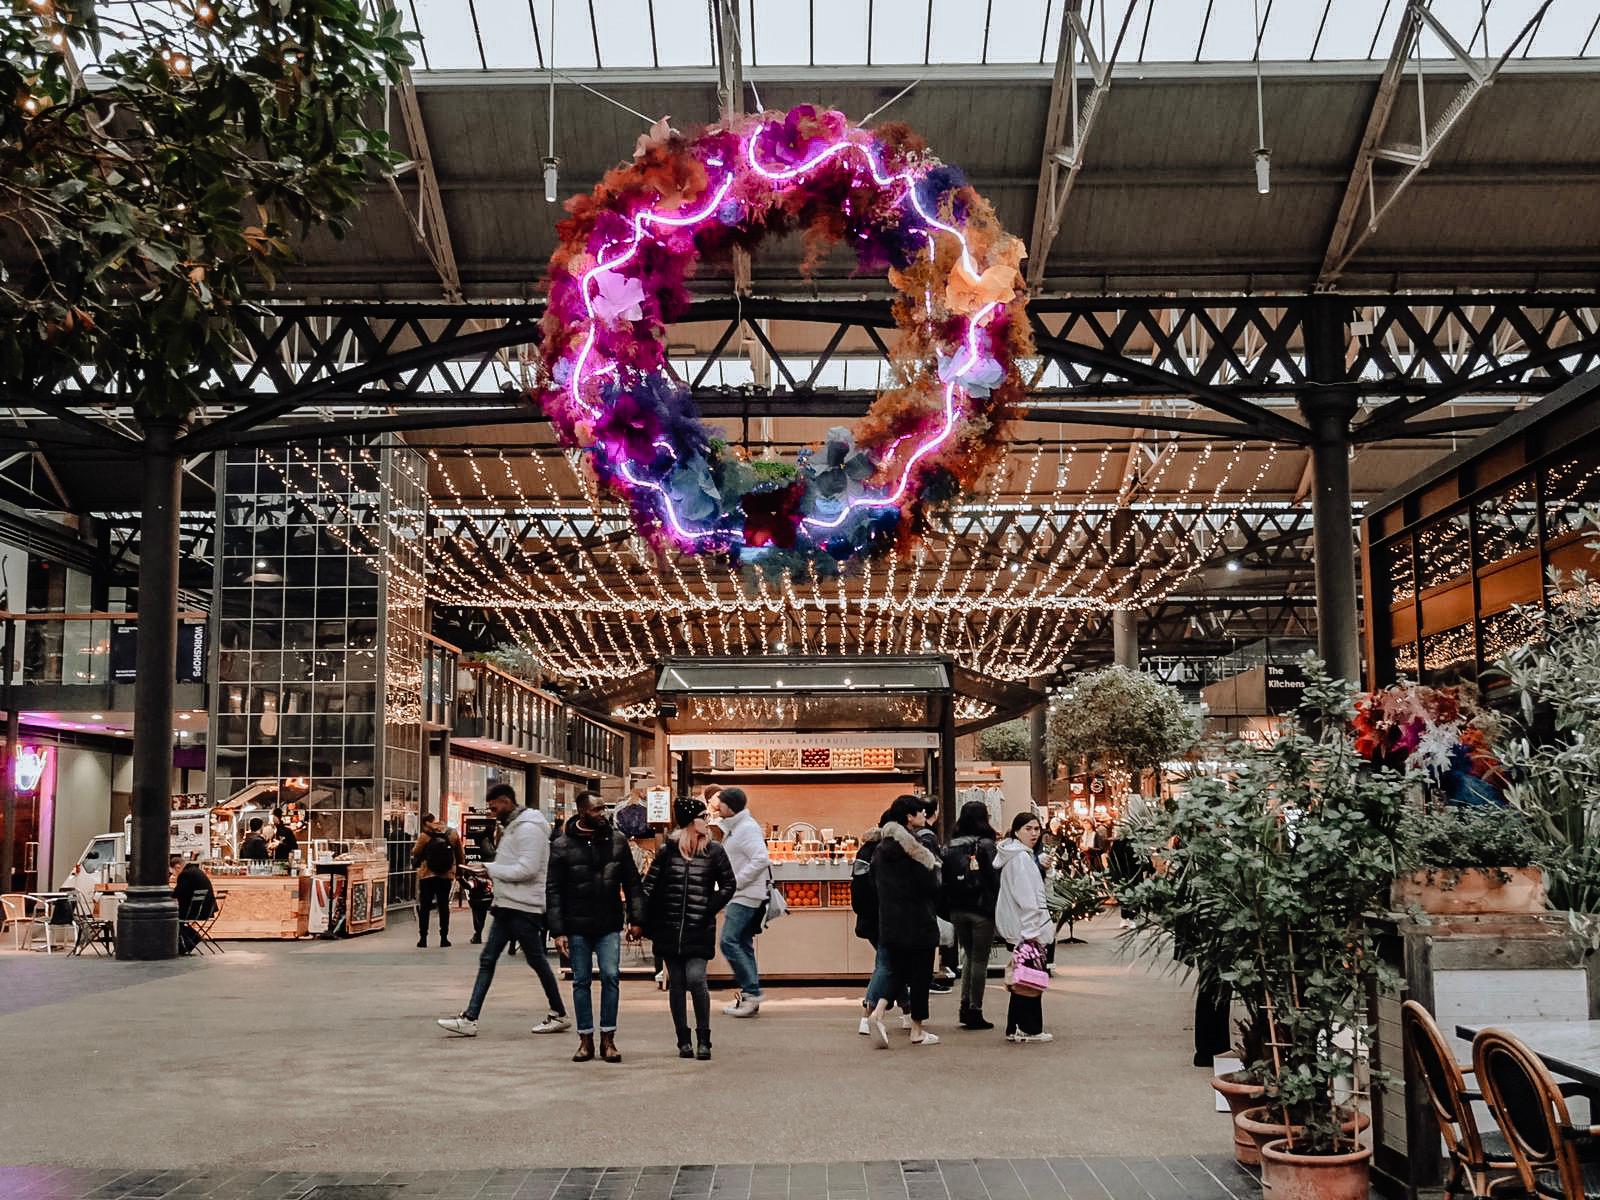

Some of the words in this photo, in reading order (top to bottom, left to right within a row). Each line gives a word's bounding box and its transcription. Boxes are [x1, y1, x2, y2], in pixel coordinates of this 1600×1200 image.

[193, 626, 204, 677] WORKSHOPS
[1268, 667, 1284, 675] The
[1268, 680, 1306, 688] Kitchens
[787, 737, 848, 745] GRAPEFRUIT
